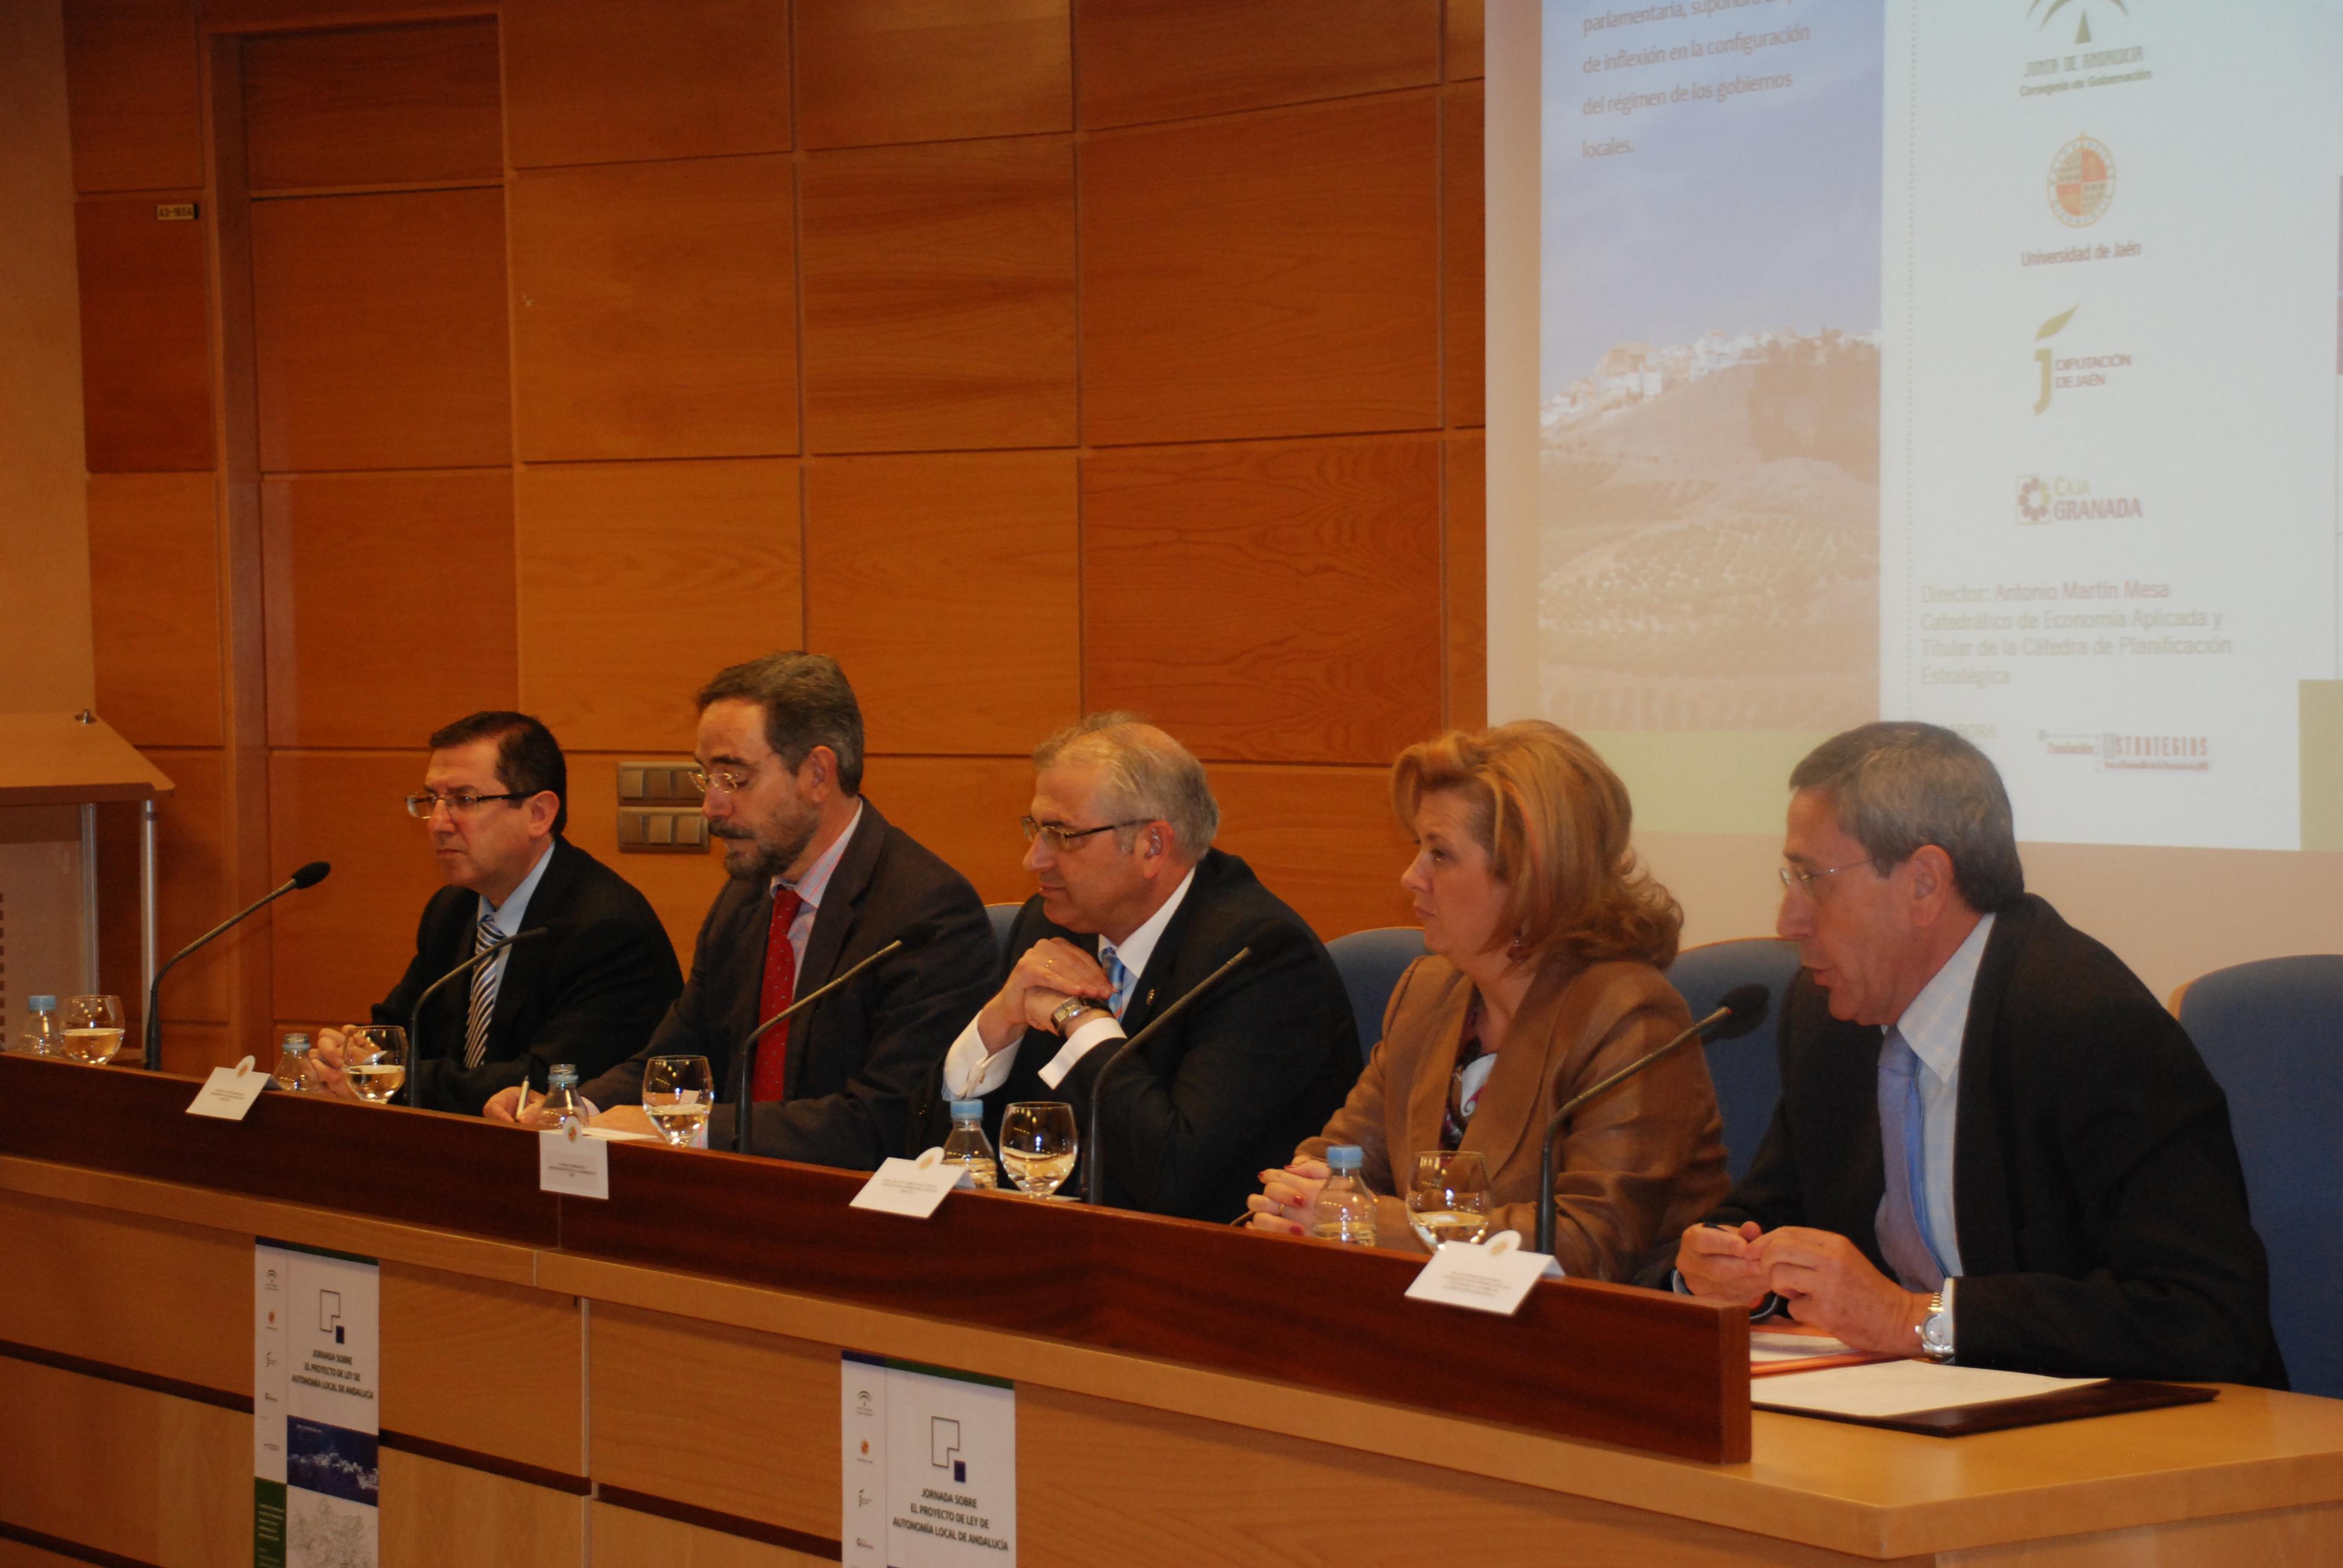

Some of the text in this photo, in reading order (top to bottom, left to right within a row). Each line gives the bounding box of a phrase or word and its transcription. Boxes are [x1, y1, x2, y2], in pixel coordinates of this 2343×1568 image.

[1583, 3, 1687, 37] parlamentaria,
[1583, 24, 1810, 73] de inflexión en la configuración
[2063, 55, 2077, 73] DE
[1583, 72, 1793, 115] del régimen de los gobiernos
[1582, 137, 1634, 158] locales.
[2020, 241, 2141, 267] Universidad de Jaén
[2055, 372, 2106, 388] DE JAÉN
[2053, 497, 2143, 521] GRANADA
[1920, 580, 2170, 604] Director: Antonio Martín Mesa
[1920, 607, 2223, 631] Catedrático de Economía Aplicada y
[1976, 638, 1997, 656] de
[2002, 638, 2017, 656] la
[2022, 636, 2088, 656] Cátedra
[2092, 637, 2115, 655] de
[2119, 635, 2232, 655] Planificación
[1921, 666, 2011, 688] Estratégica
[921, 1488, 977, 1508] JORNADA SOBRE
[910, 1503, 989, 1529] EL PROYECTO DE LEY DE
[893, 1517, 1009, 1551] AUTONOMÍA LOCAL DE ANDALUCÍA
